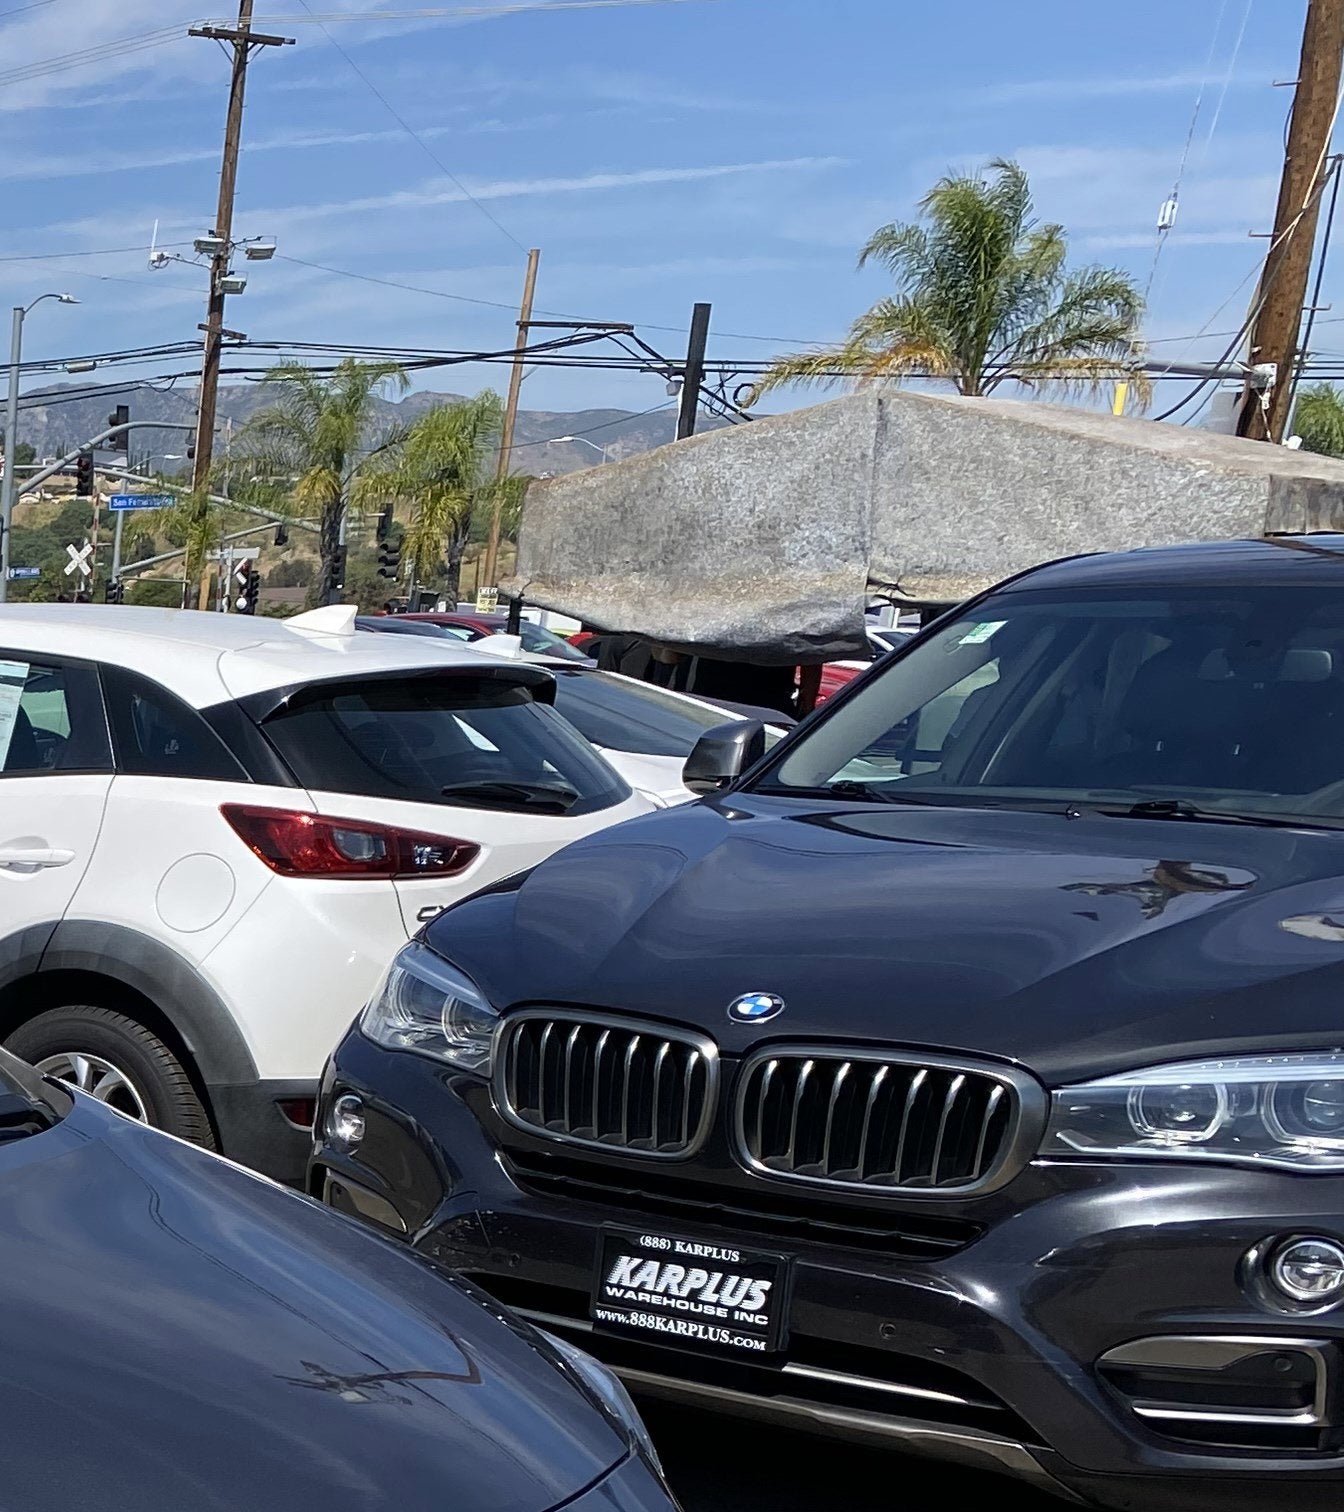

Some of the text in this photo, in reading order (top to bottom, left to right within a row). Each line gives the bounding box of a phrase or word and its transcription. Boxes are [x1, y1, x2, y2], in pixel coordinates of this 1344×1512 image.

[113, 498, 127, 507] San
[639, 1235, 740, 1262] (888) KARPLUS
[606, 1255, 772, 1311] KARPLUS
[606, 1286, 769, 1325] WAREHOUSE INC
